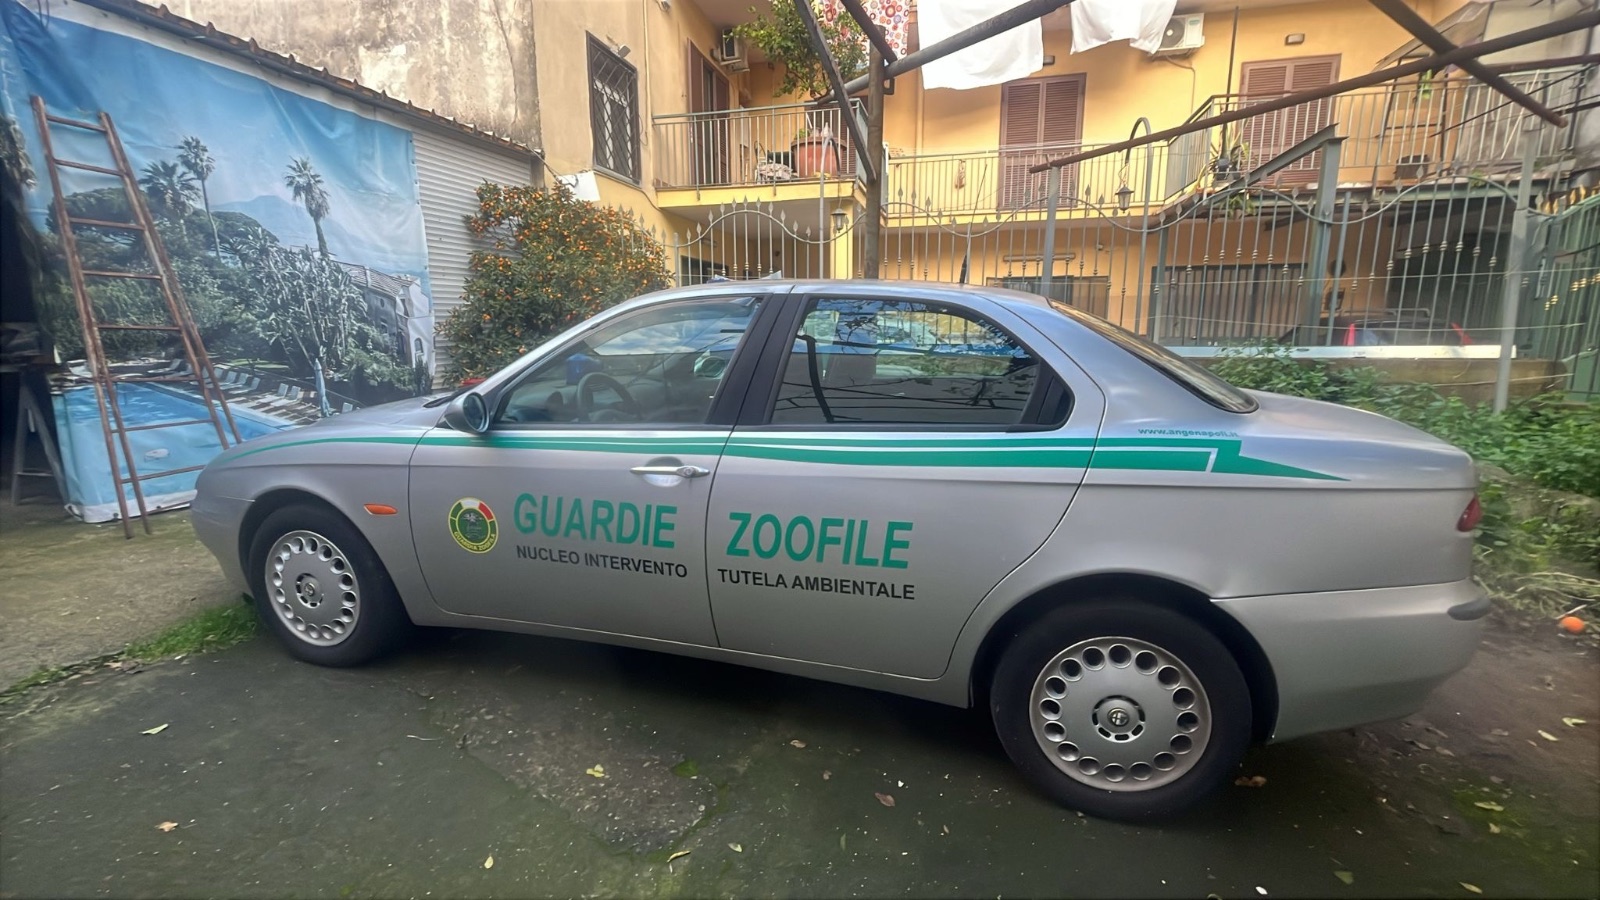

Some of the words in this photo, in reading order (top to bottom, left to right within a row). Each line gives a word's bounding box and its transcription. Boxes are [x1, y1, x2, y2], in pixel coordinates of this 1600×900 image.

[514, 493, 677, 548] GUARDIE
[726, 512, 913, 569] ZOOFILE
[517, 545, 580, 565] NUCLEO
[585, 553, 688, 578] INTERVENTO
[717, 569, 788, 588] TUTELA
[791, 575, 915, 600] AMBIENTALE
